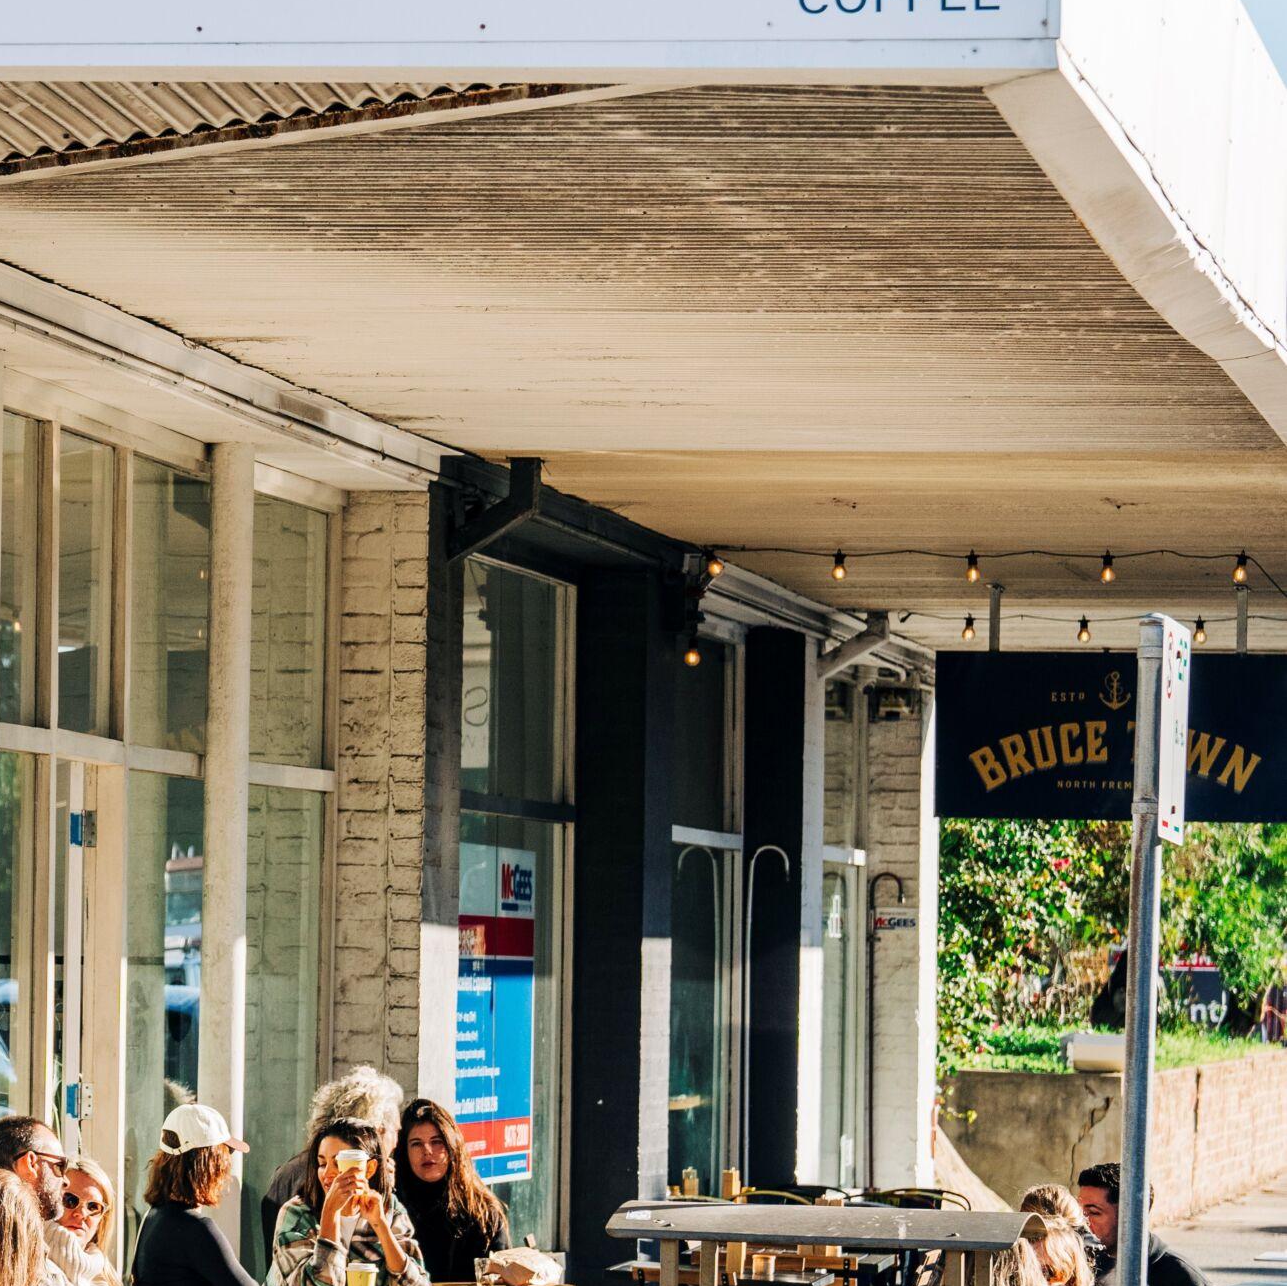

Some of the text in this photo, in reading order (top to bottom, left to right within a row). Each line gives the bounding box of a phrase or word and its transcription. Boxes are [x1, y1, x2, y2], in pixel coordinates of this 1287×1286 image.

[969, 720, 1108, 792] BRUCE
[1127, 720, 1262, 794] WN
[1057, 780, 1133, 790] NORTH FREM
